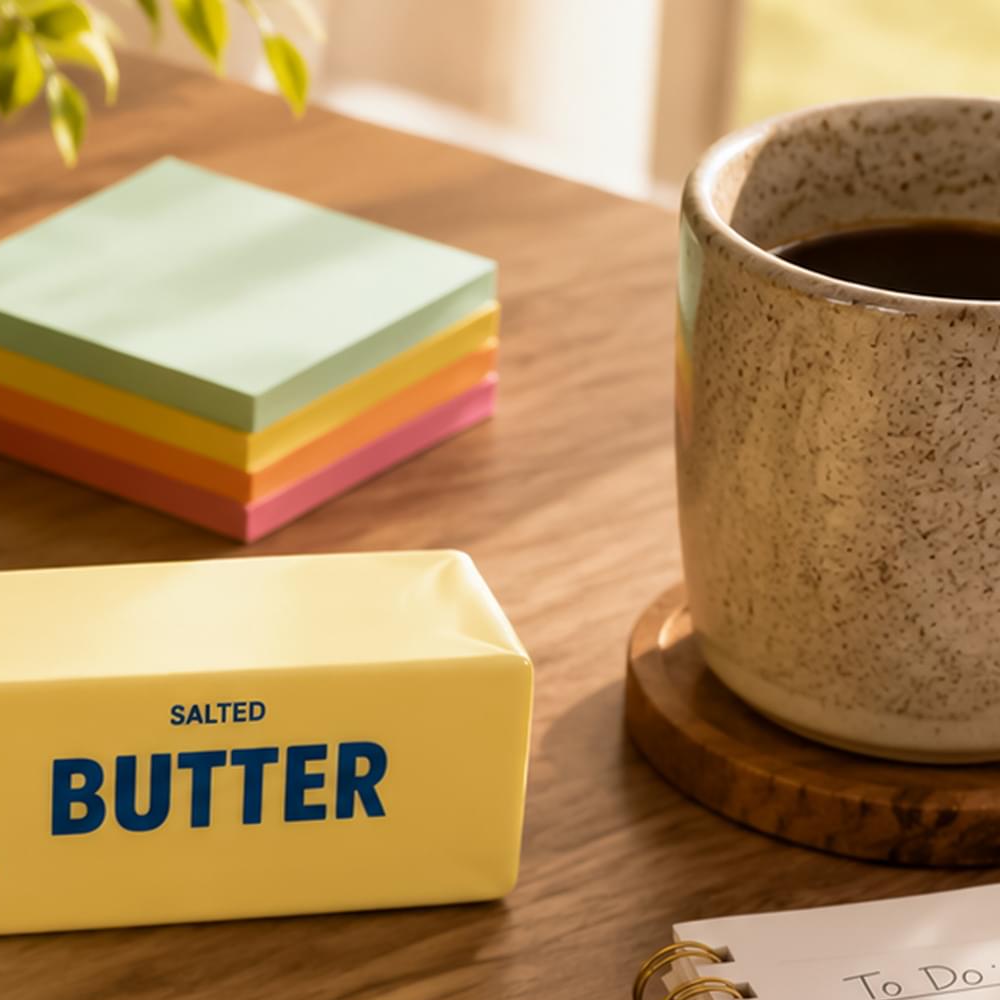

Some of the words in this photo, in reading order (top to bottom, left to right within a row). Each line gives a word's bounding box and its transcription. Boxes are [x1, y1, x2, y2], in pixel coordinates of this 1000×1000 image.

[169, 700, 267, 726] SALTED
[50, 740, 389, 837] BUTTER
[842, 970, 904, 1000] To
